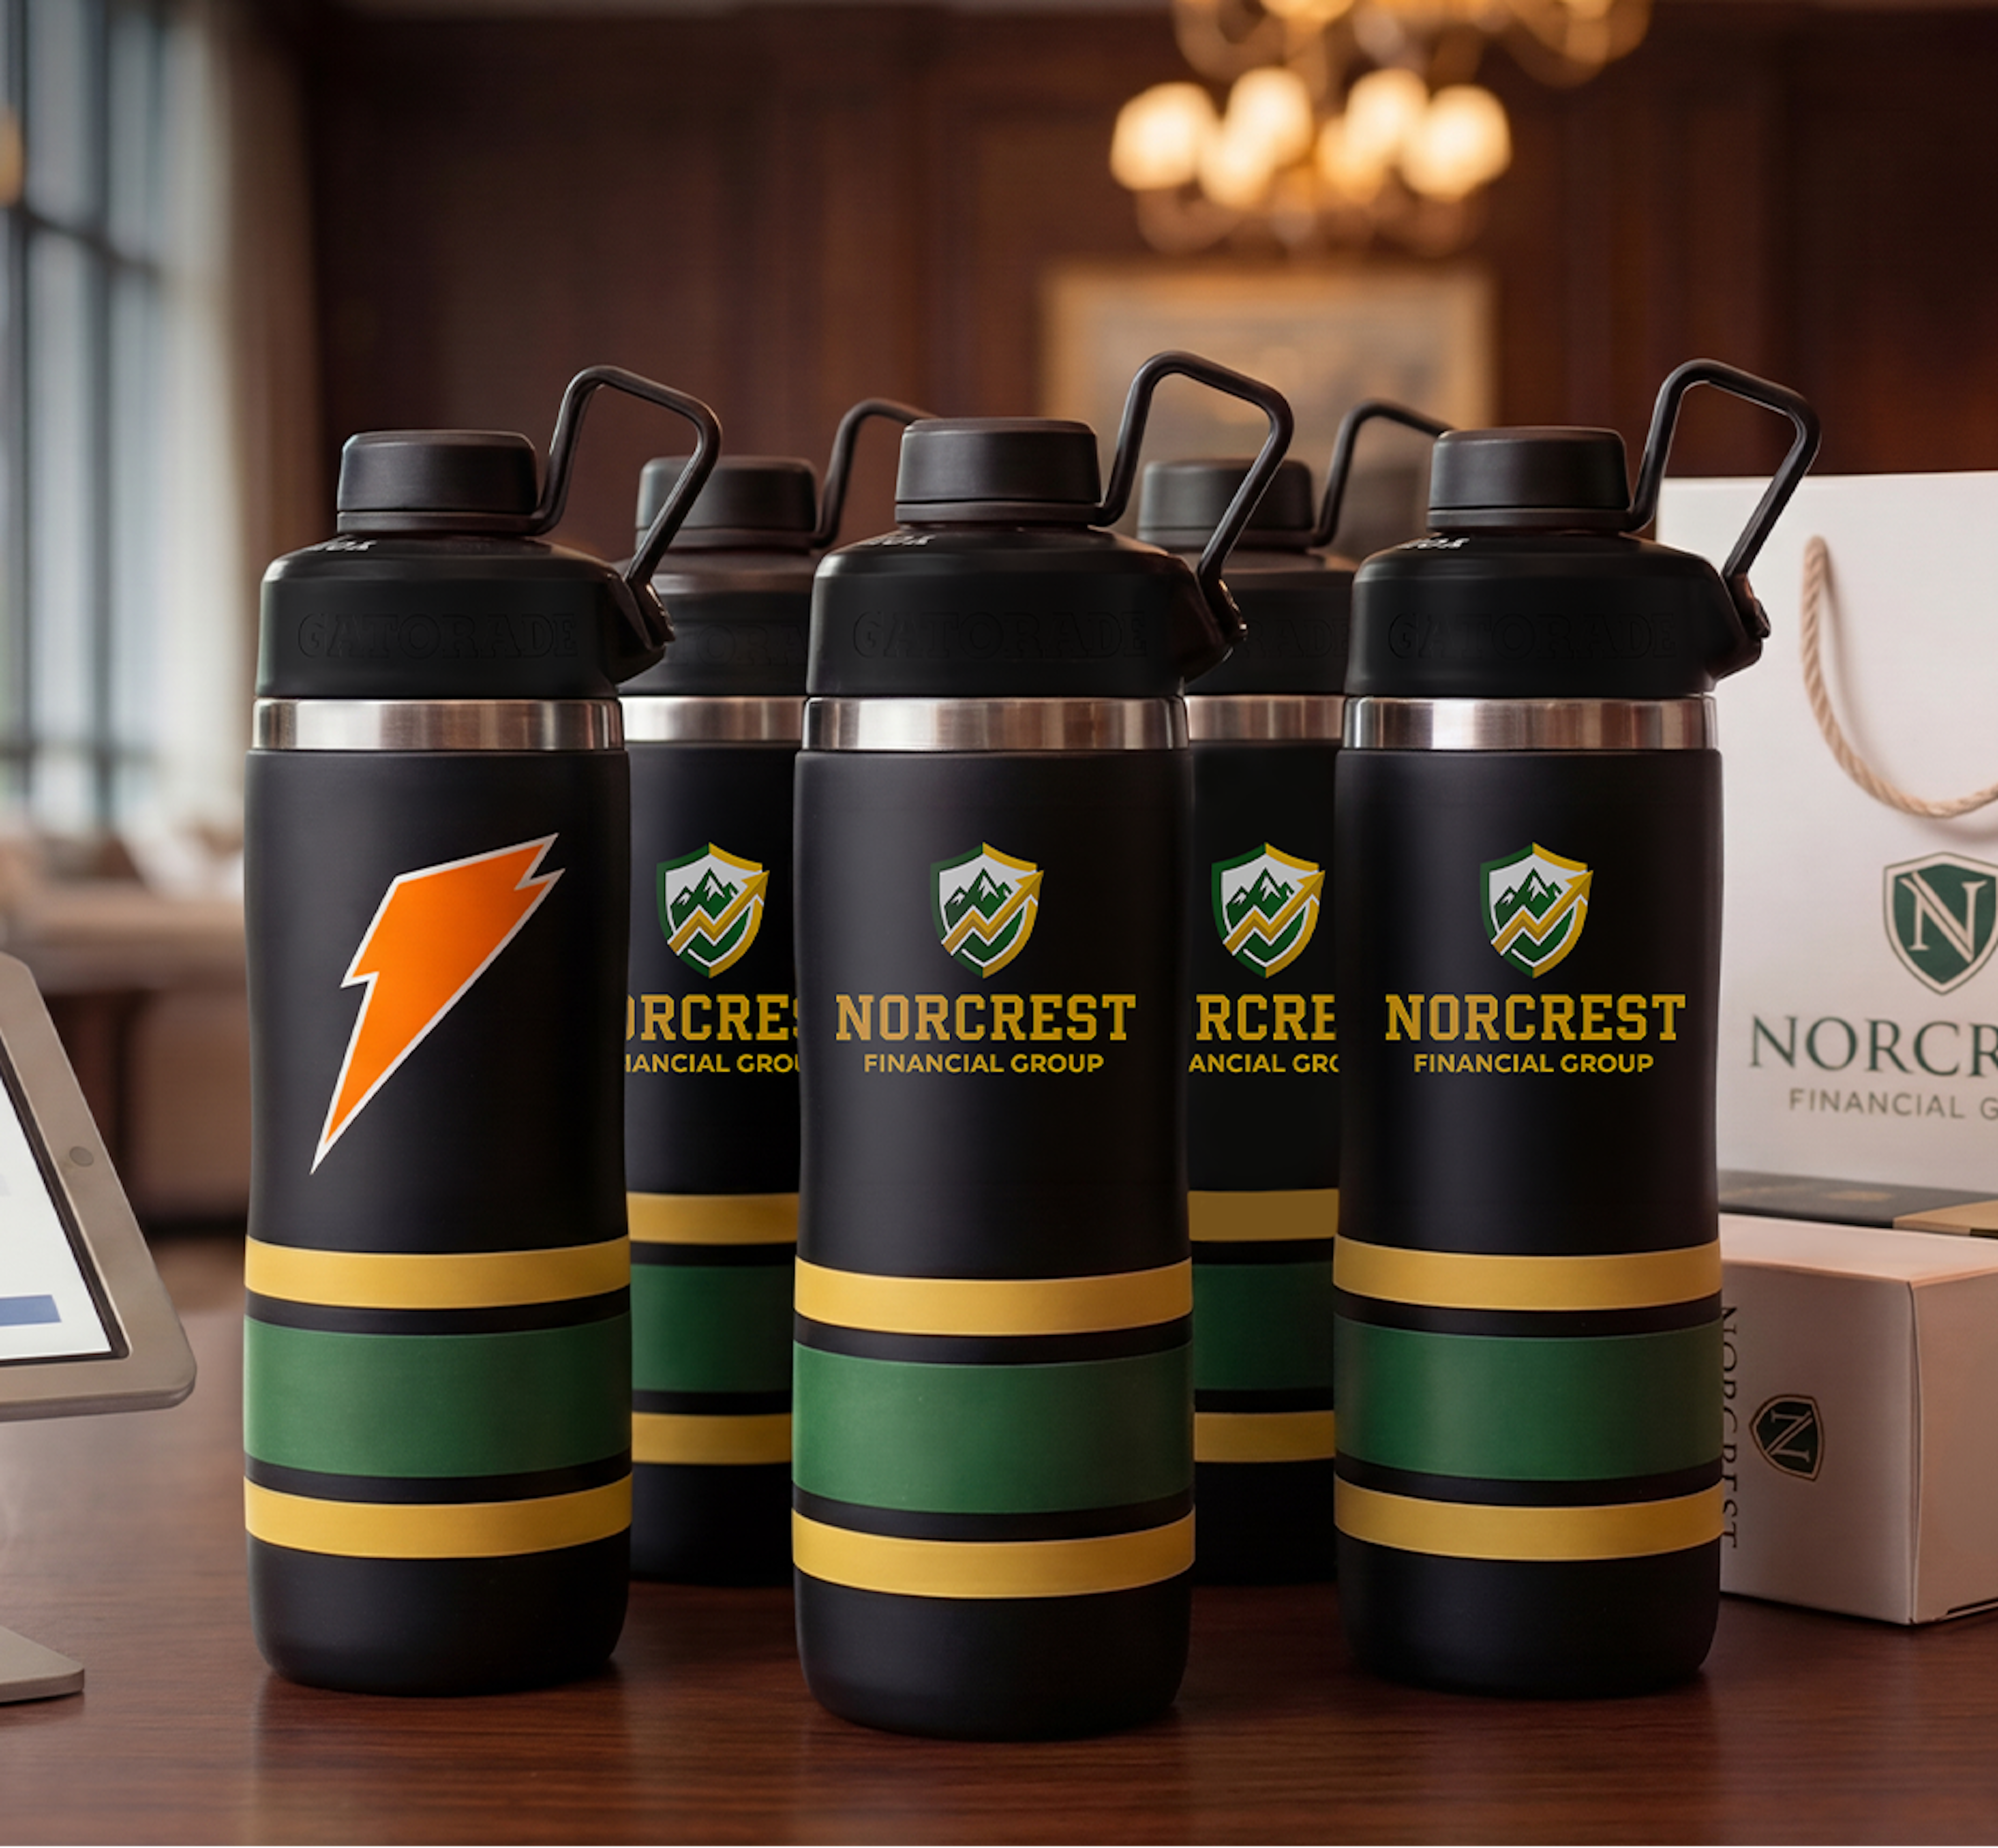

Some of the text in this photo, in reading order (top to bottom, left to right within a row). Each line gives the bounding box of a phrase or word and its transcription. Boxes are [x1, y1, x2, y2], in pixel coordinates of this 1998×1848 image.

[297, 612, 579, 660] GATORADE
[853, 611, 1147, 659] GATORADE
[1387, 612, 1676, 660] GATORADE
[626, 994, 799, 1041] RCRE
[835, 994, 1136, 1041] NORCREST
[1385, 994, 1686, 1041] NORCREST
[864, 1054, 1104, 1073] FINANCIAL GROUP
[1414, 1054, 1654, 1073] FINANCIAL GROUP
[1790, 1088, 1966, 1119] FINANCIAL
